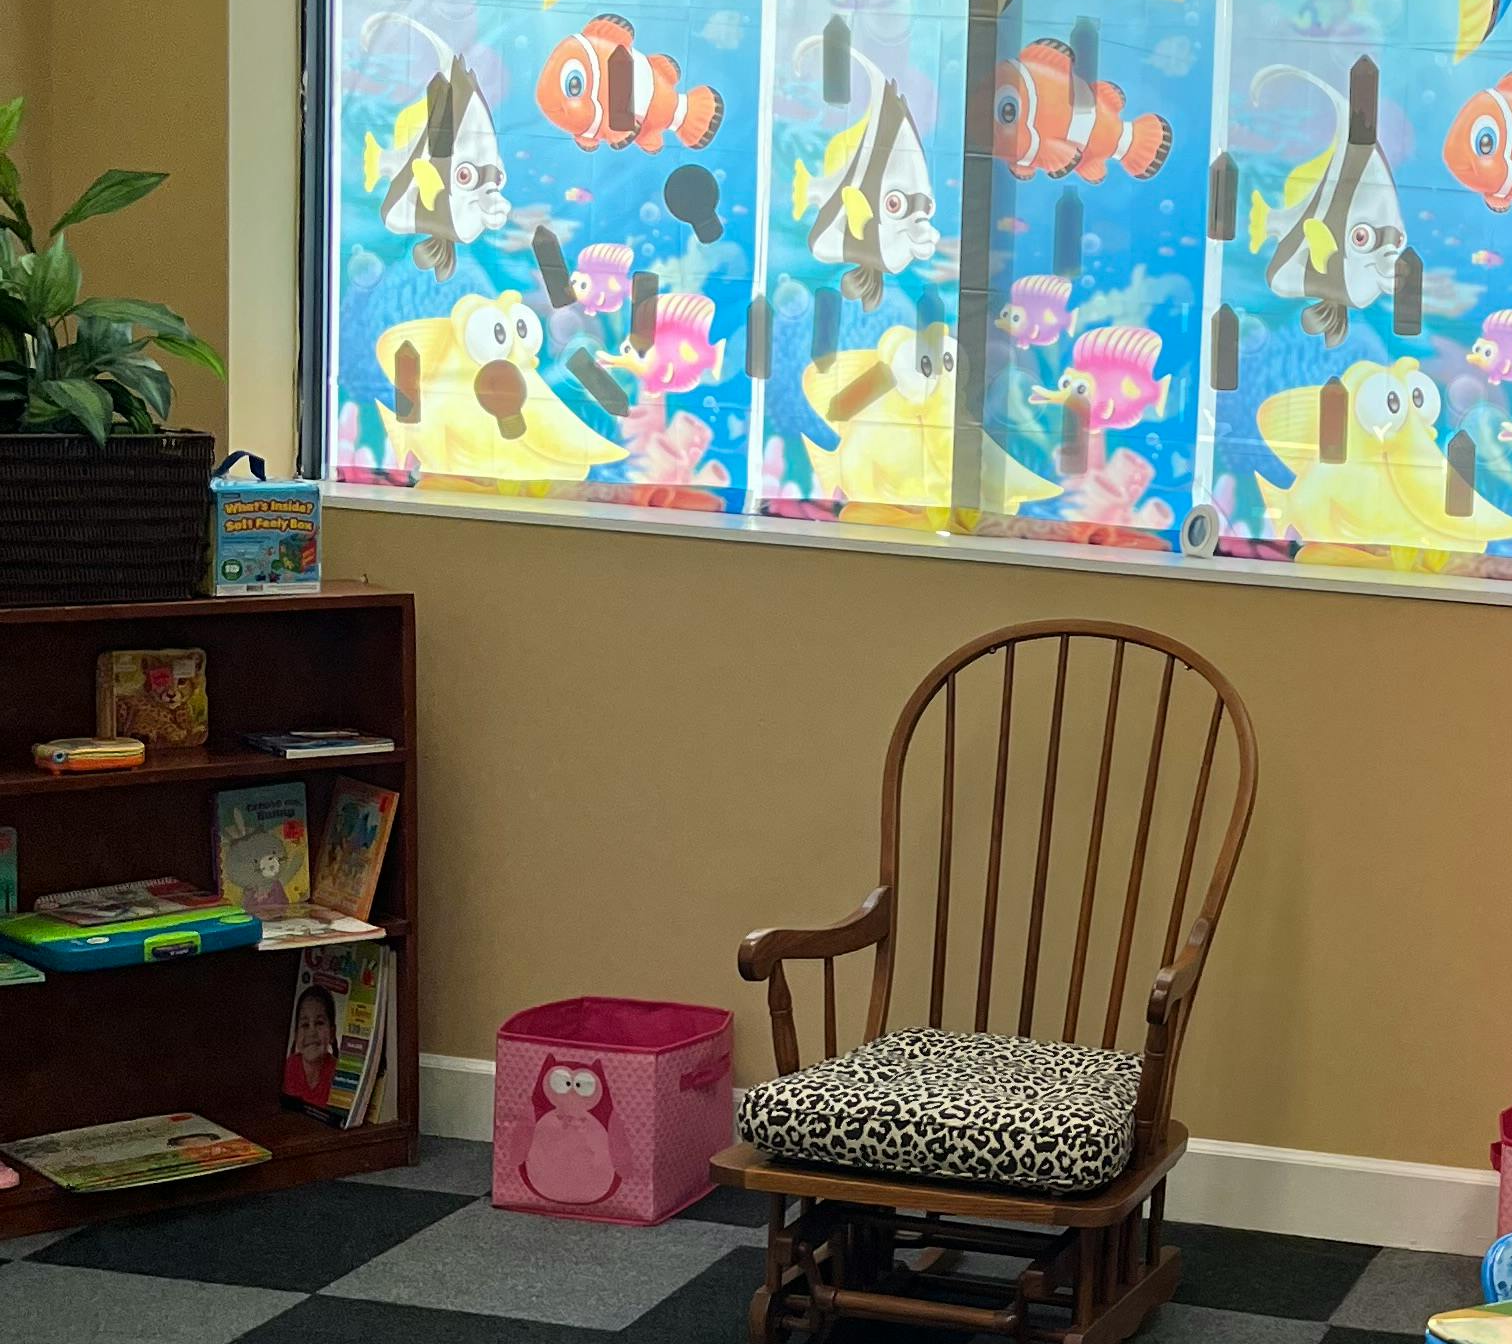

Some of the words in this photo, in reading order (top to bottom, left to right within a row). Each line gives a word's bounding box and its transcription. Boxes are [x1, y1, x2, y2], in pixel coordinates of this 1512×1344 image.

[225, 500, 269, 514] What's
[270, 499, 314, 514] Inside?
[255, 518, 289, 532] Feely
[289, 518, 313, 531] Box
